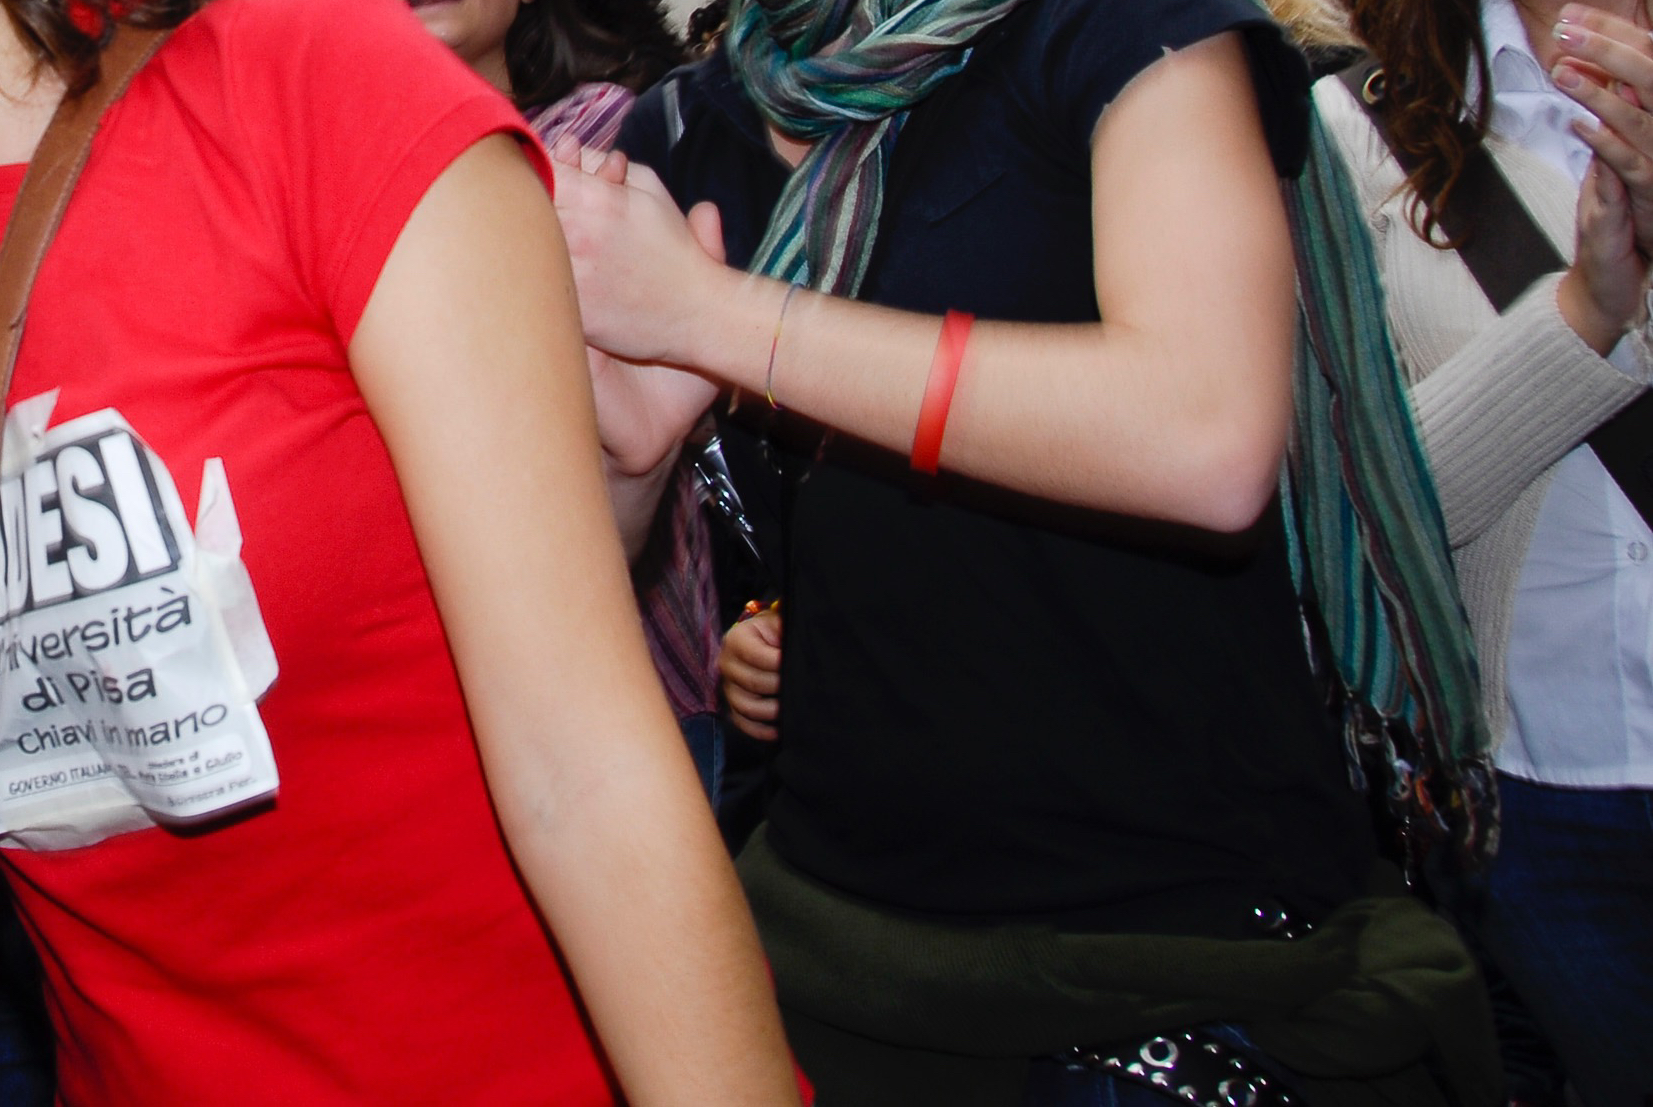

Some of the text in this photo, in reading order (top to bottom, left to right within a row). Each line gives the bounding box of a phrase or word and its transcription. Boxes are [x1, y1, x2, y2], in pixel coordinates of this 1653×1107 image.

[22, 667, 158, 712] di Pisa
[17, 719, 95, 755] Chiavi
[124, 703, 228, 749] mano
[9, 770, 68, 796] GOVERNO
